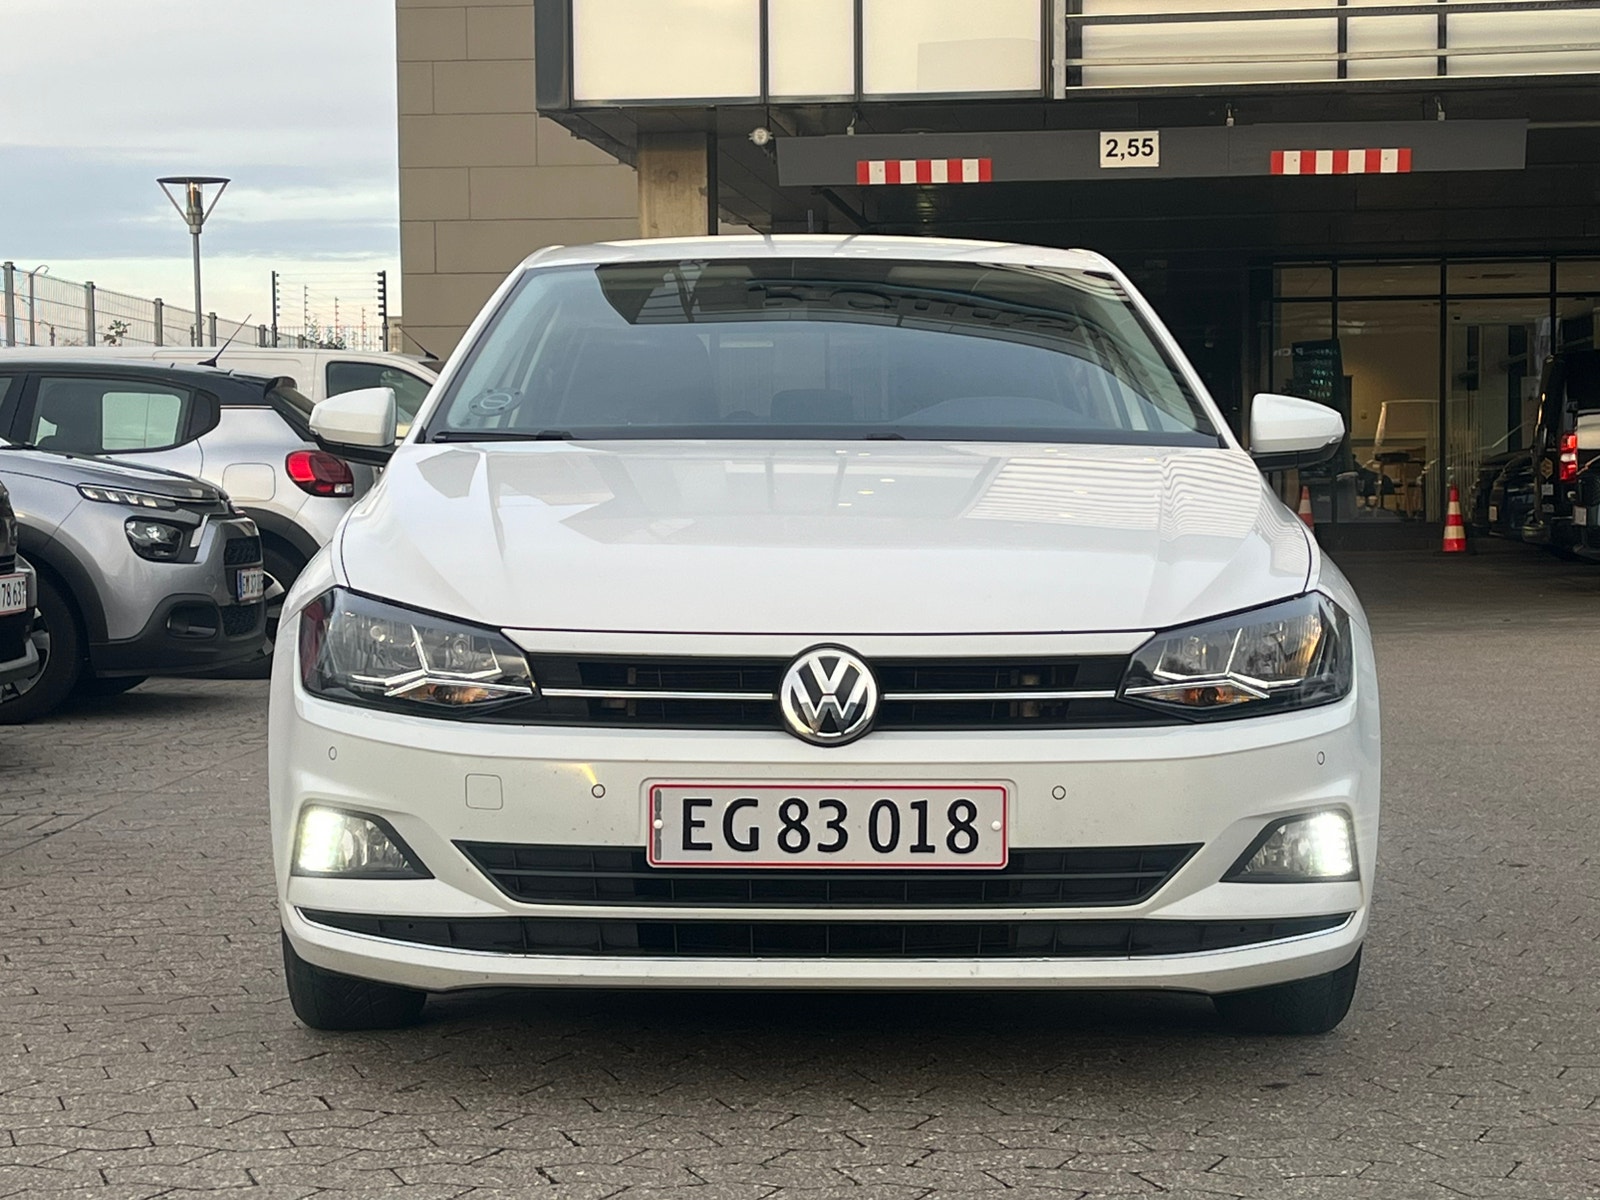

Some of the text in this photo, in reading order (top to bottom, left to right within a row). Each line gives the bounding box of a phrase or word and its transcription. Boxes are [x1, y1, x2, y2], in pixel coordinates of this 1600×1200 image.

[1105, 137, 1154, 161] 2,55
[1, 582, 12, 608] 78
[784, 649, 874, 737] VW
[682, 797, 980, 855] EG 83 018
